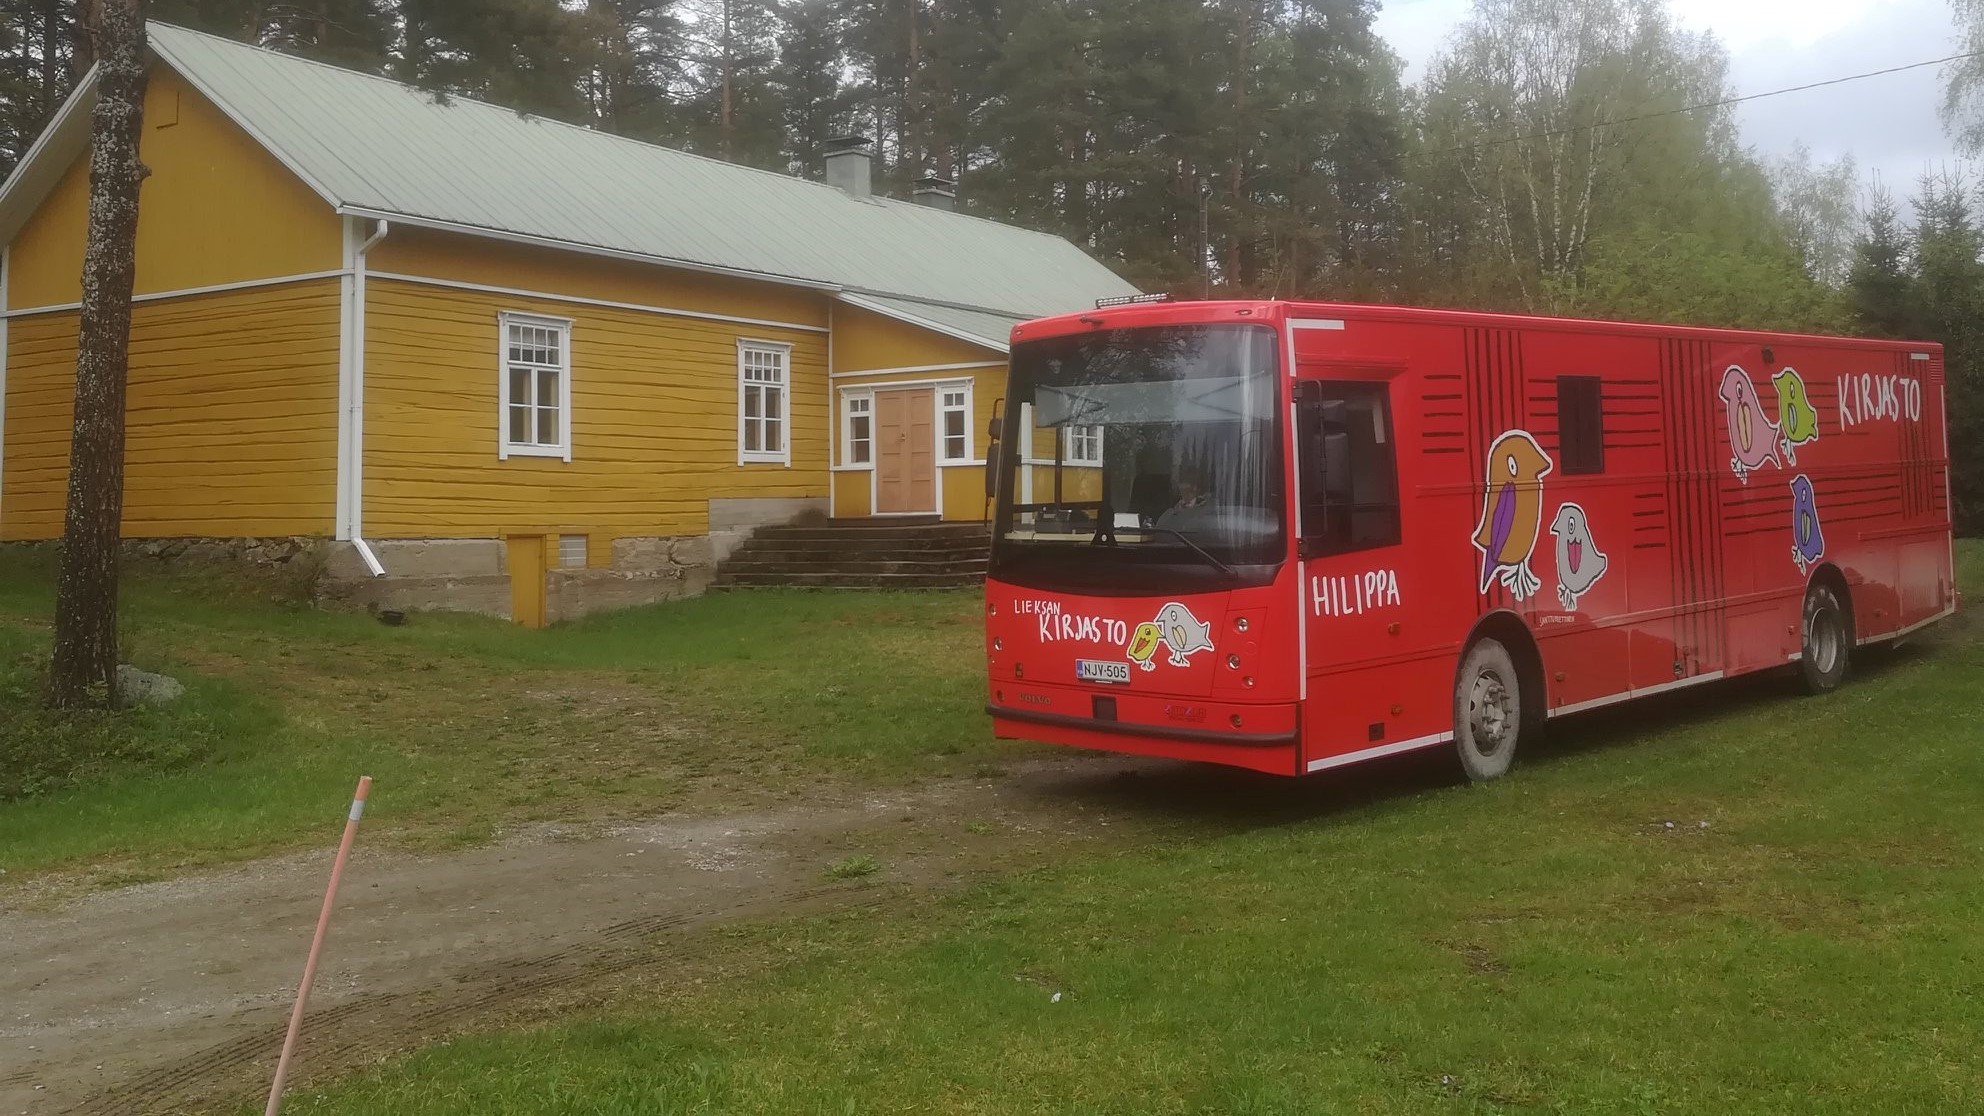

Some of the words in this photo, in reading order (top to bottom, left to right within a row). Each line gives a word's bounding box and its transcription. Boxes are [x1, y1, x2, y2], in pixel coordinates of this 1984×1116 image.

[1838, 373, 1920, 431] KIRJASTO
[1014, 599, 1061, 615] LIEKSAN
[1312, 569, 1401, 617] HILIPPA
[1039, 613, 1127, 646] KIRJASTO
[1084, 663, 1127, 678] NJV-505
